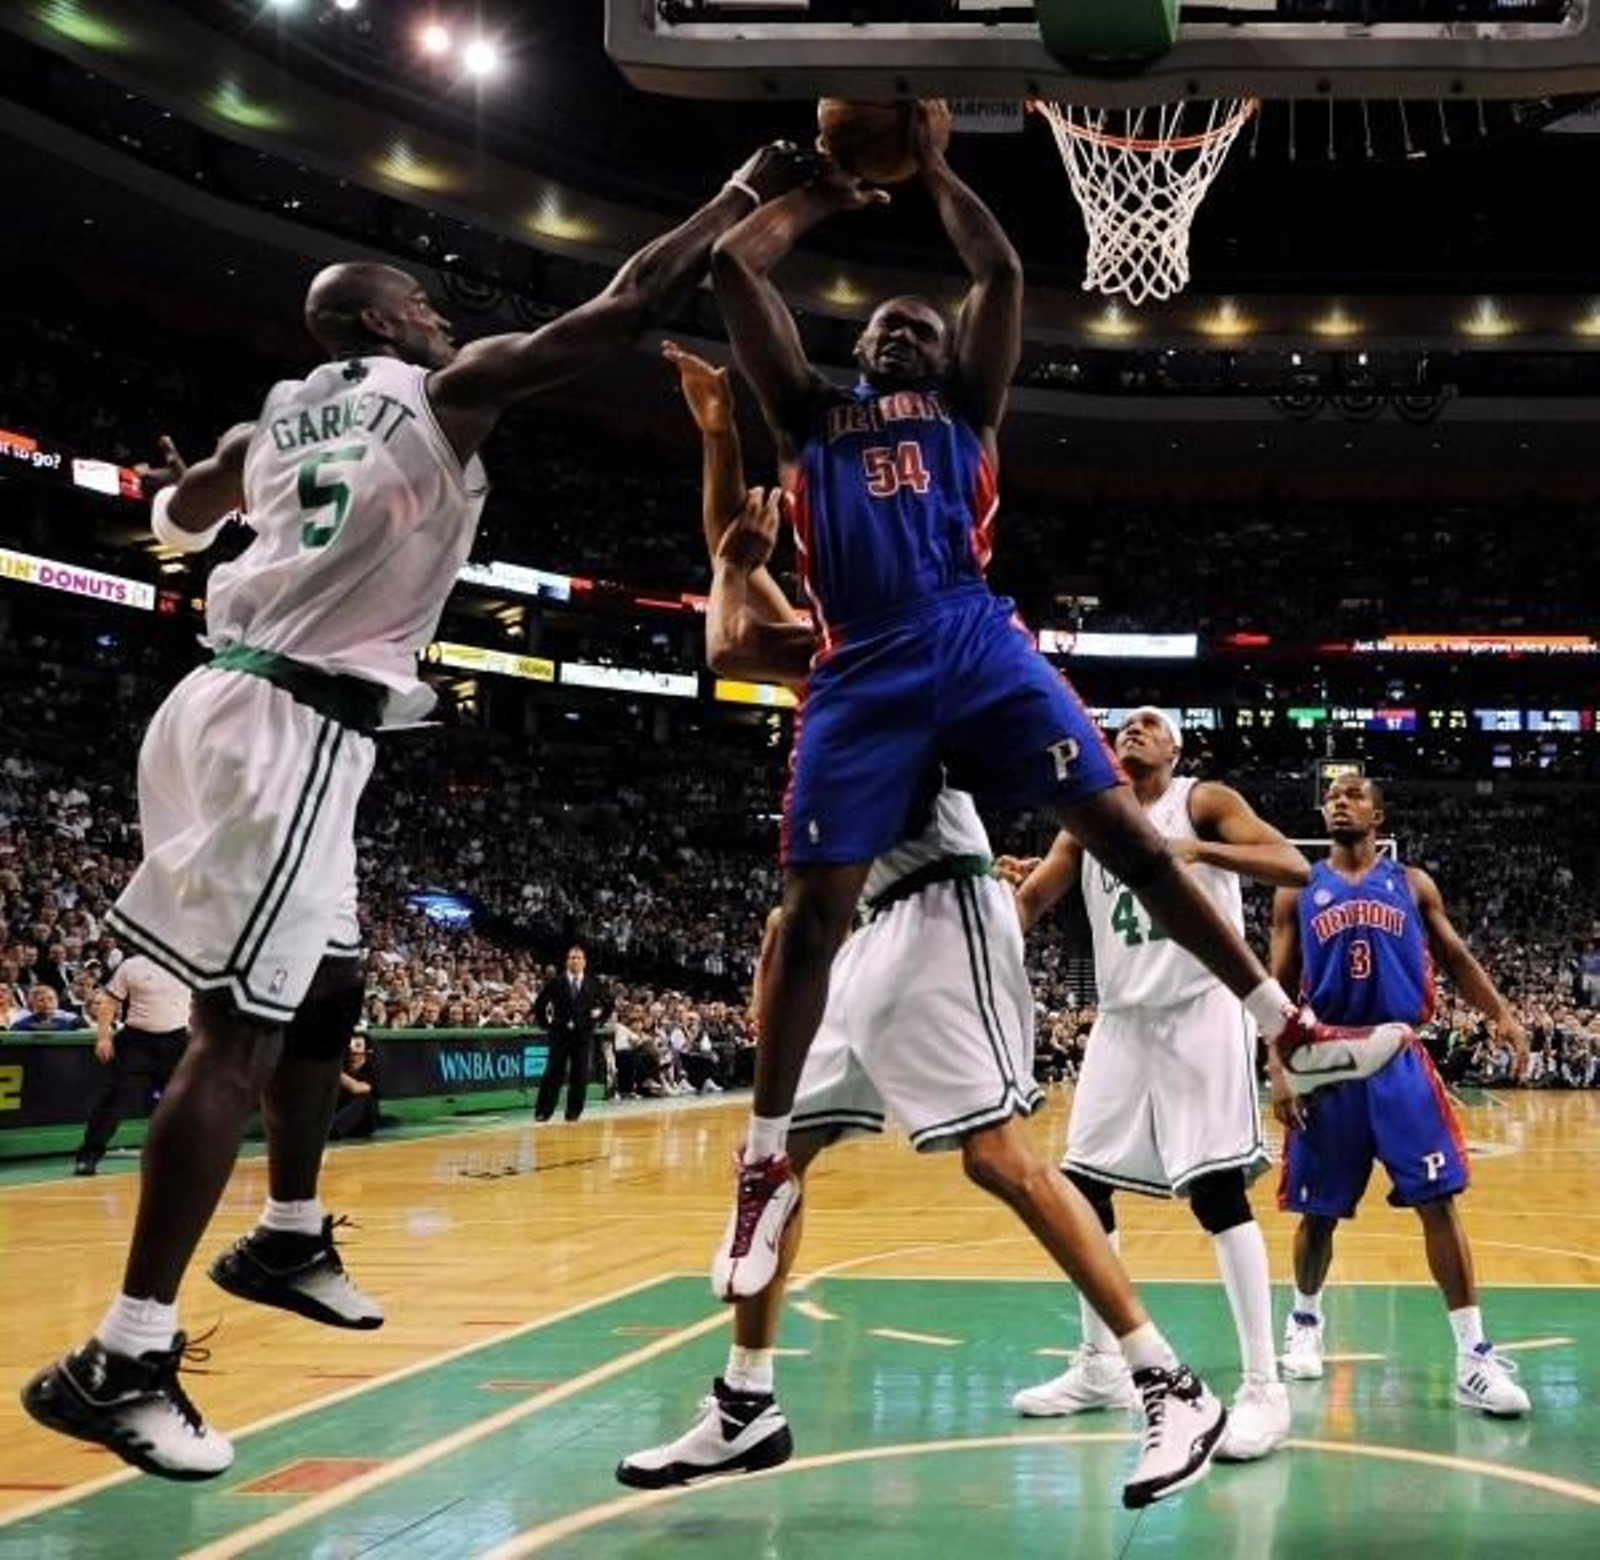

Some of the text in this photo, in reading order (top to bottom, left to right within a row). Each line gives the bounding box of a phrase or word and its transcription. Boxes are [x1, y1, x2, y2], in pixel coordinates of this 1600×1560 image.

[32, 452, 61, 469] go?
[863, 441, 930, 496] 54
[297, 446, 367, 549] 5
[38, 566, 128, 601] DONUTS
[1046, 737, 1079, 781] P
[1310, 900, 1406, 944] DETROIT
[1349, 939, 1371, 979] 3
[439, 1051, 495, 1083] WNBA
[497, 1054, 522, 1078] ON
[1421, 1150, 1446, 1181] P
